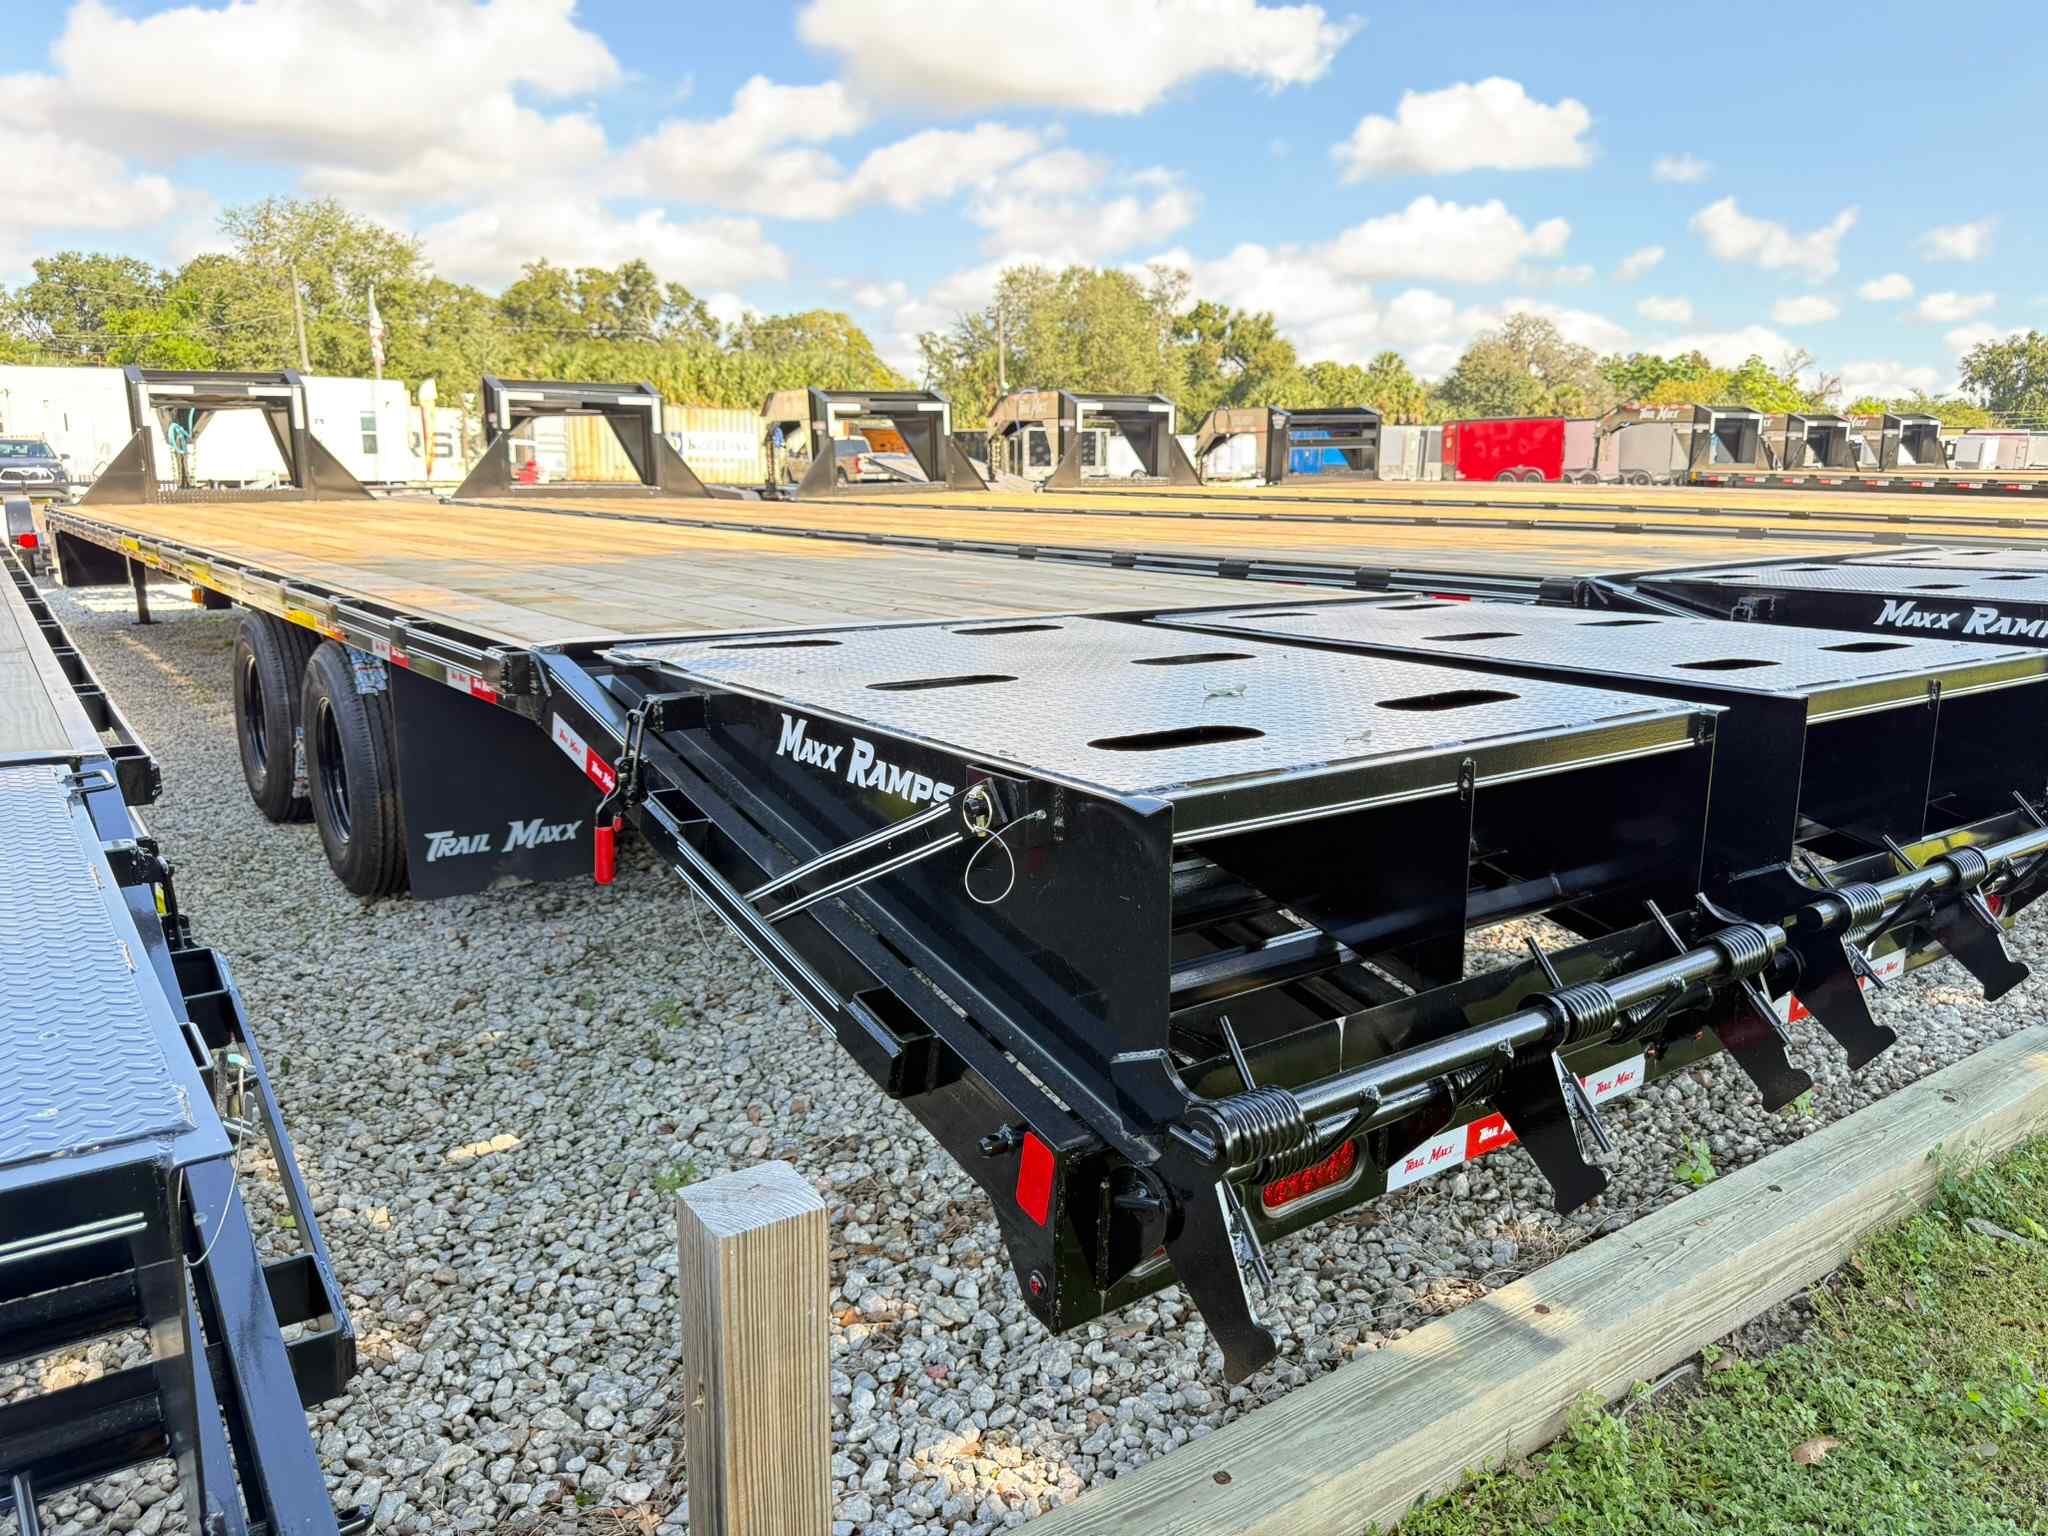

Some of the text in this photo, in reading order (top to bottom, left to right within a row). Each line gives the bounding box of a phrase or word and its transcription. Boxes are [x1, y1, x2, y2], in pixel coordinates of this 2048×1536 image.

[1873, 599, 1960, 630] MAXX
[776, 712, 956, 807] MAXX RAMPS
[423, 818, 583, 863] TRAIL MAXX
